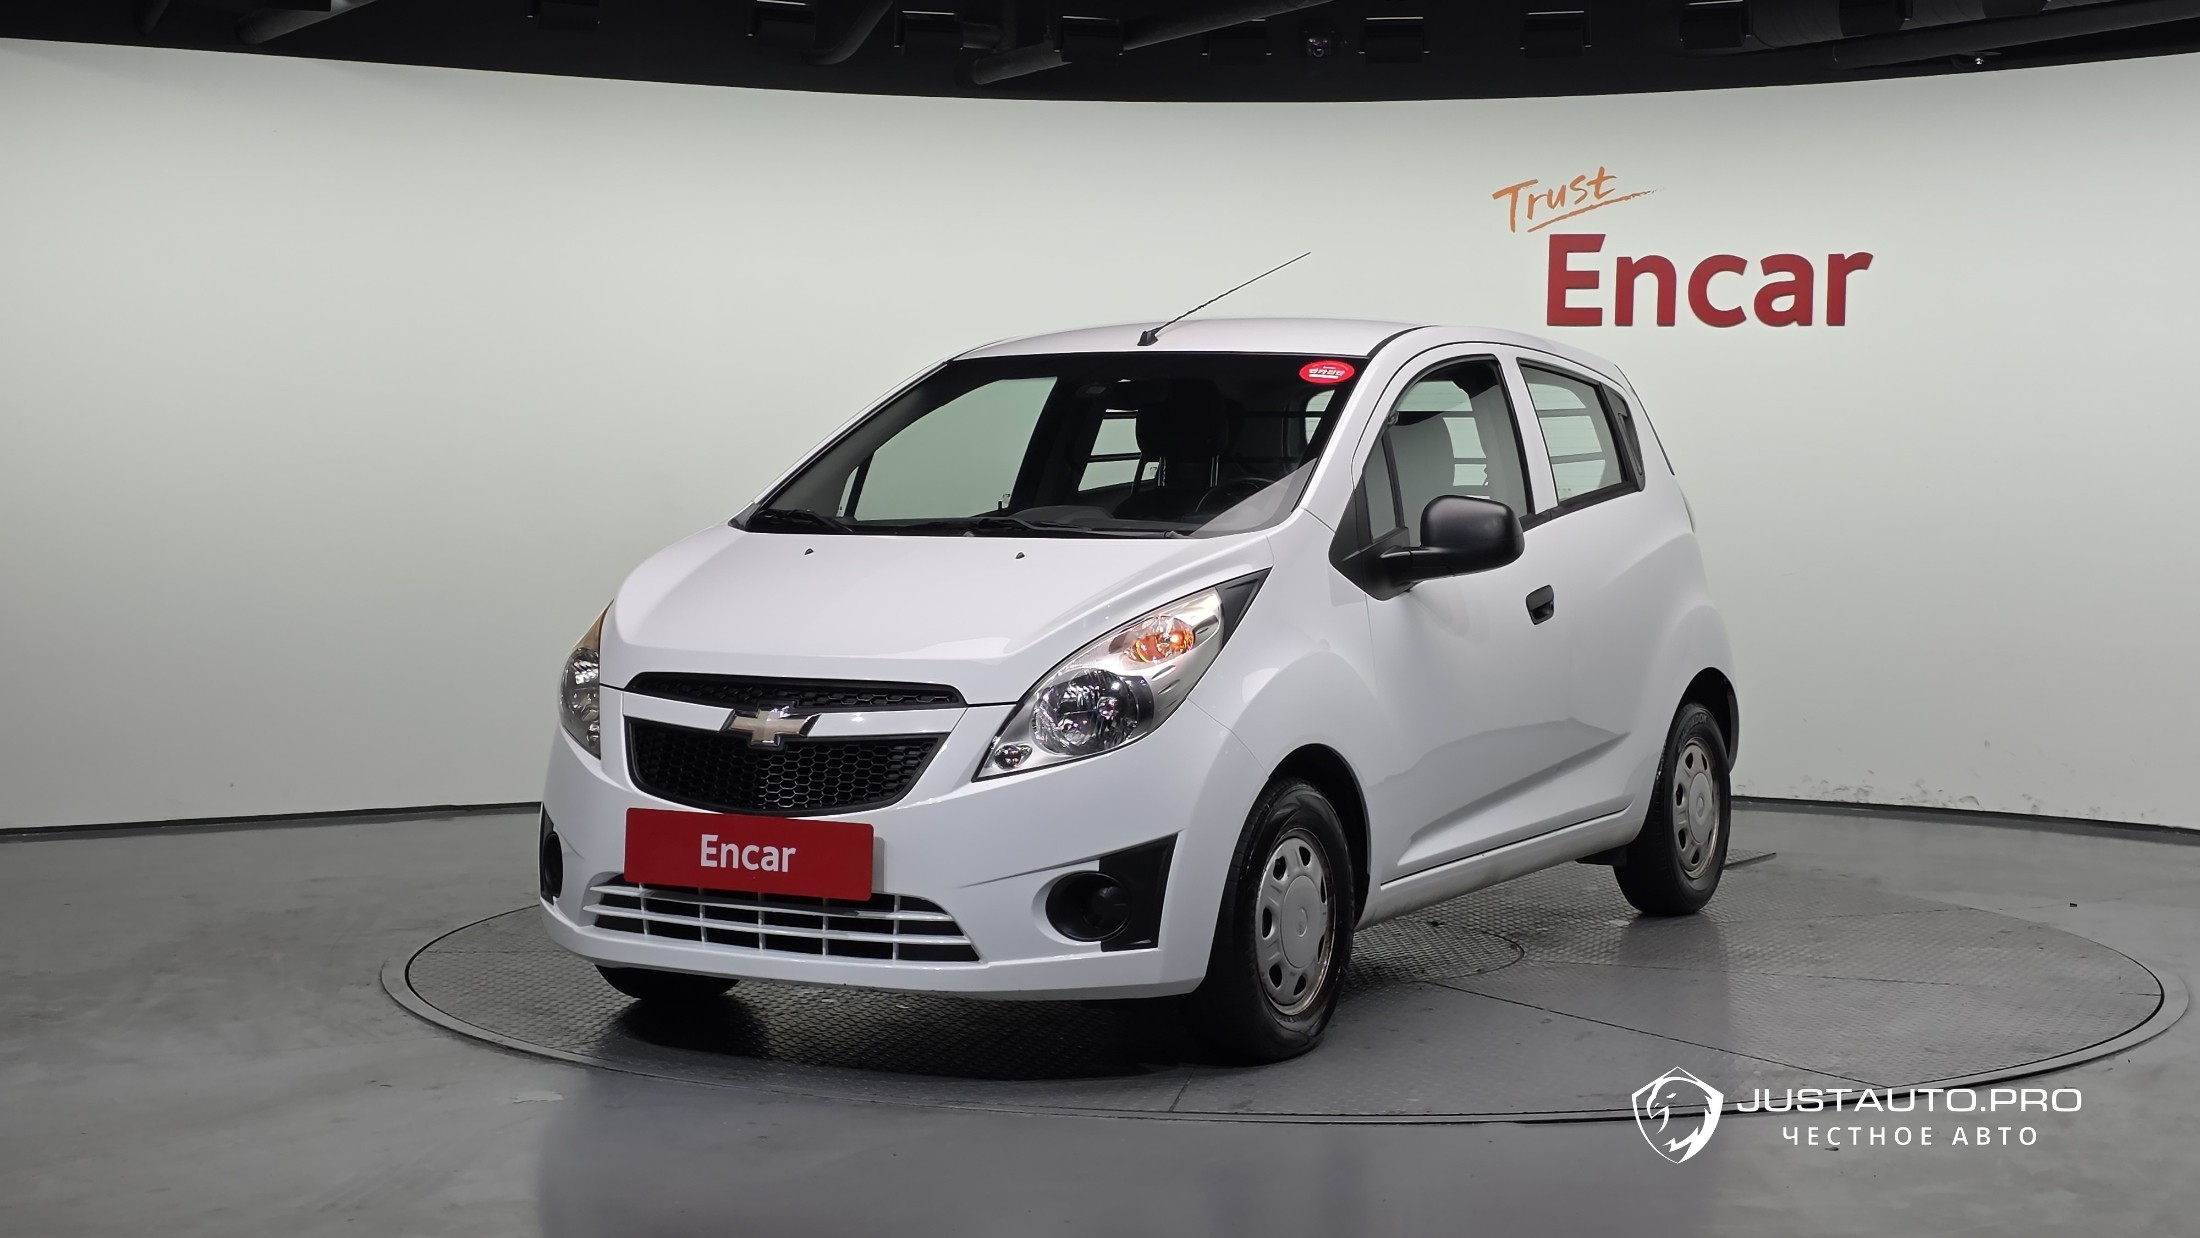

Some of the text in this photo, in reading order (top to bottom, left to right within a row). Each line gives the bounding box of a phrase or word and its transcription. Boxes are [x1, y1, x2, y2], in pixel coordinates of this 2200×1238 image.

[1492, 166, 1617, 233] Trust
[1547, 233, 1874, 328] Encar
[700, 833, 797, 873] Encar
